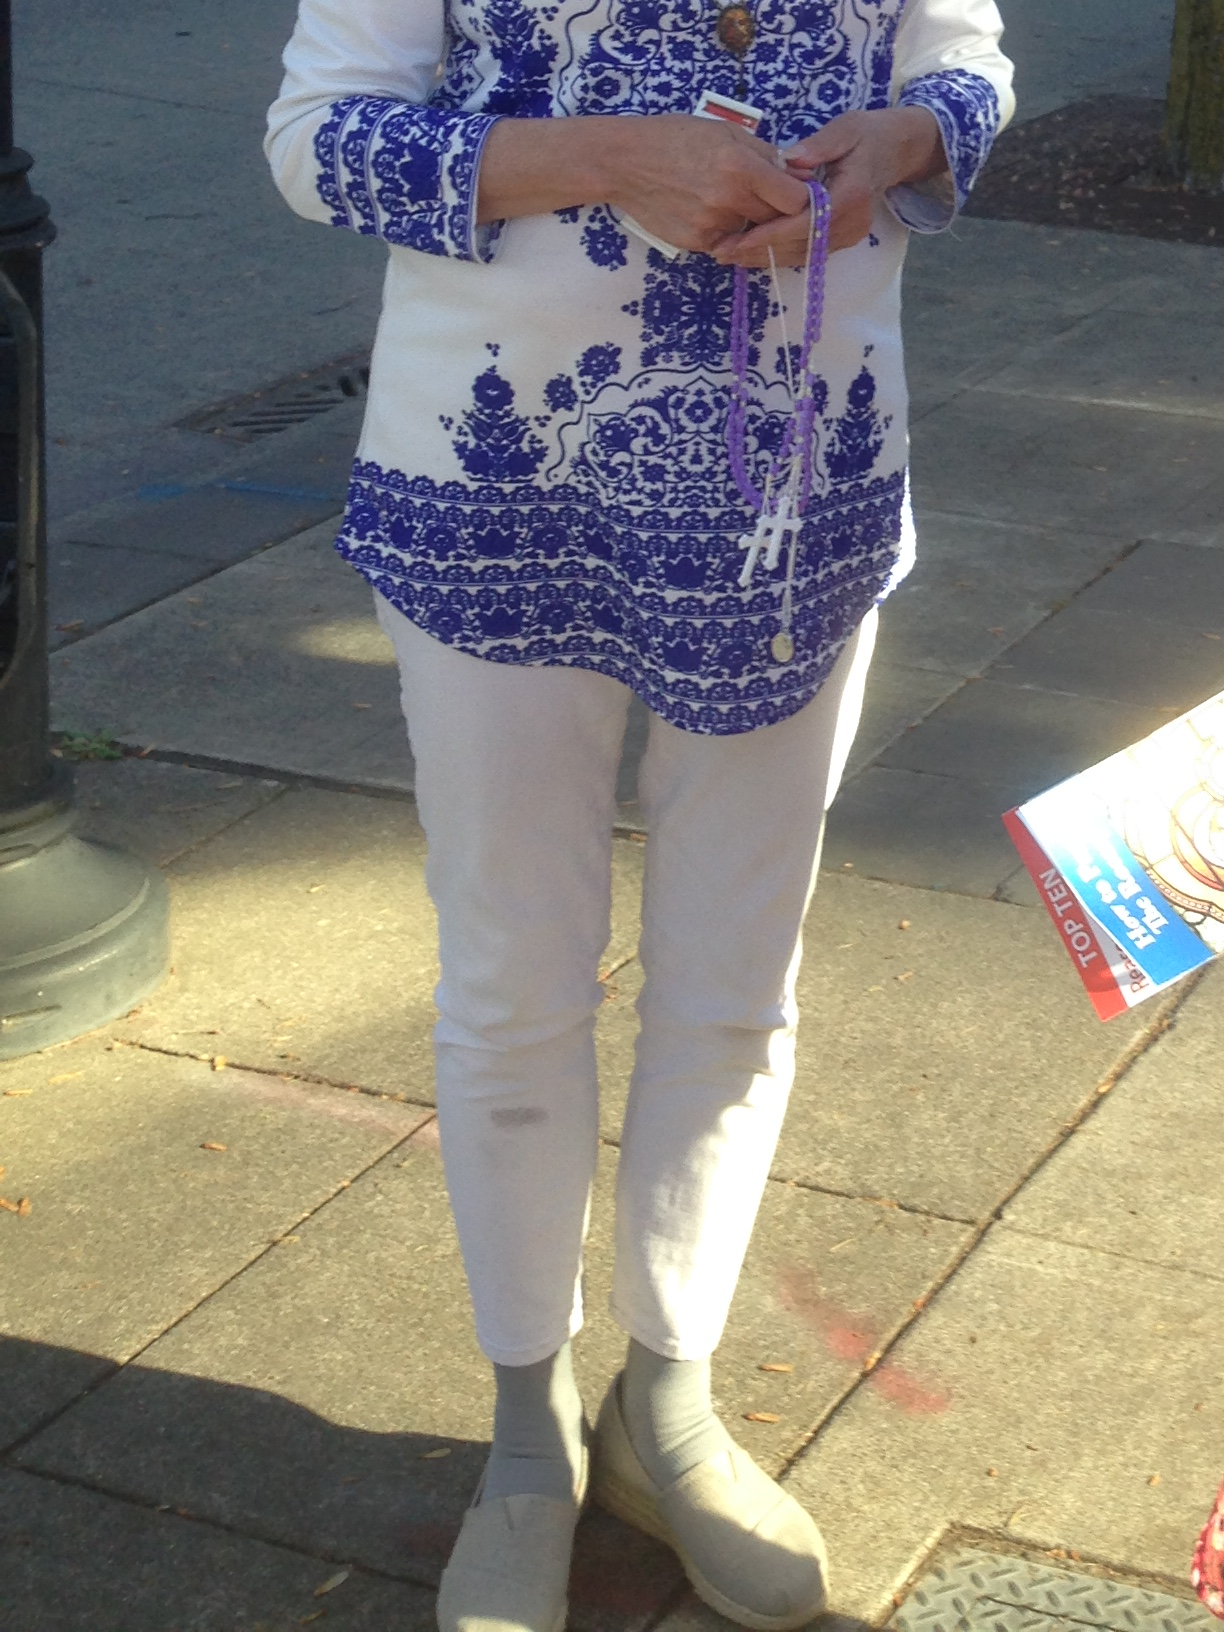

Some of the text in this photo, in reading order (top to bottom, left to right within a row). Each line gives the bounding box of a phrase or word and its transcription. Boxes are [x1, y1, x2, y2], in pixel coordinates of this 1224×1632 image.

[1093, 877, 1116, 905] to
[1038, 866, 1098, 968] TOP TEN
[1108, 903, 1156, 951] How
[1134, 894, 1169, 935] The
